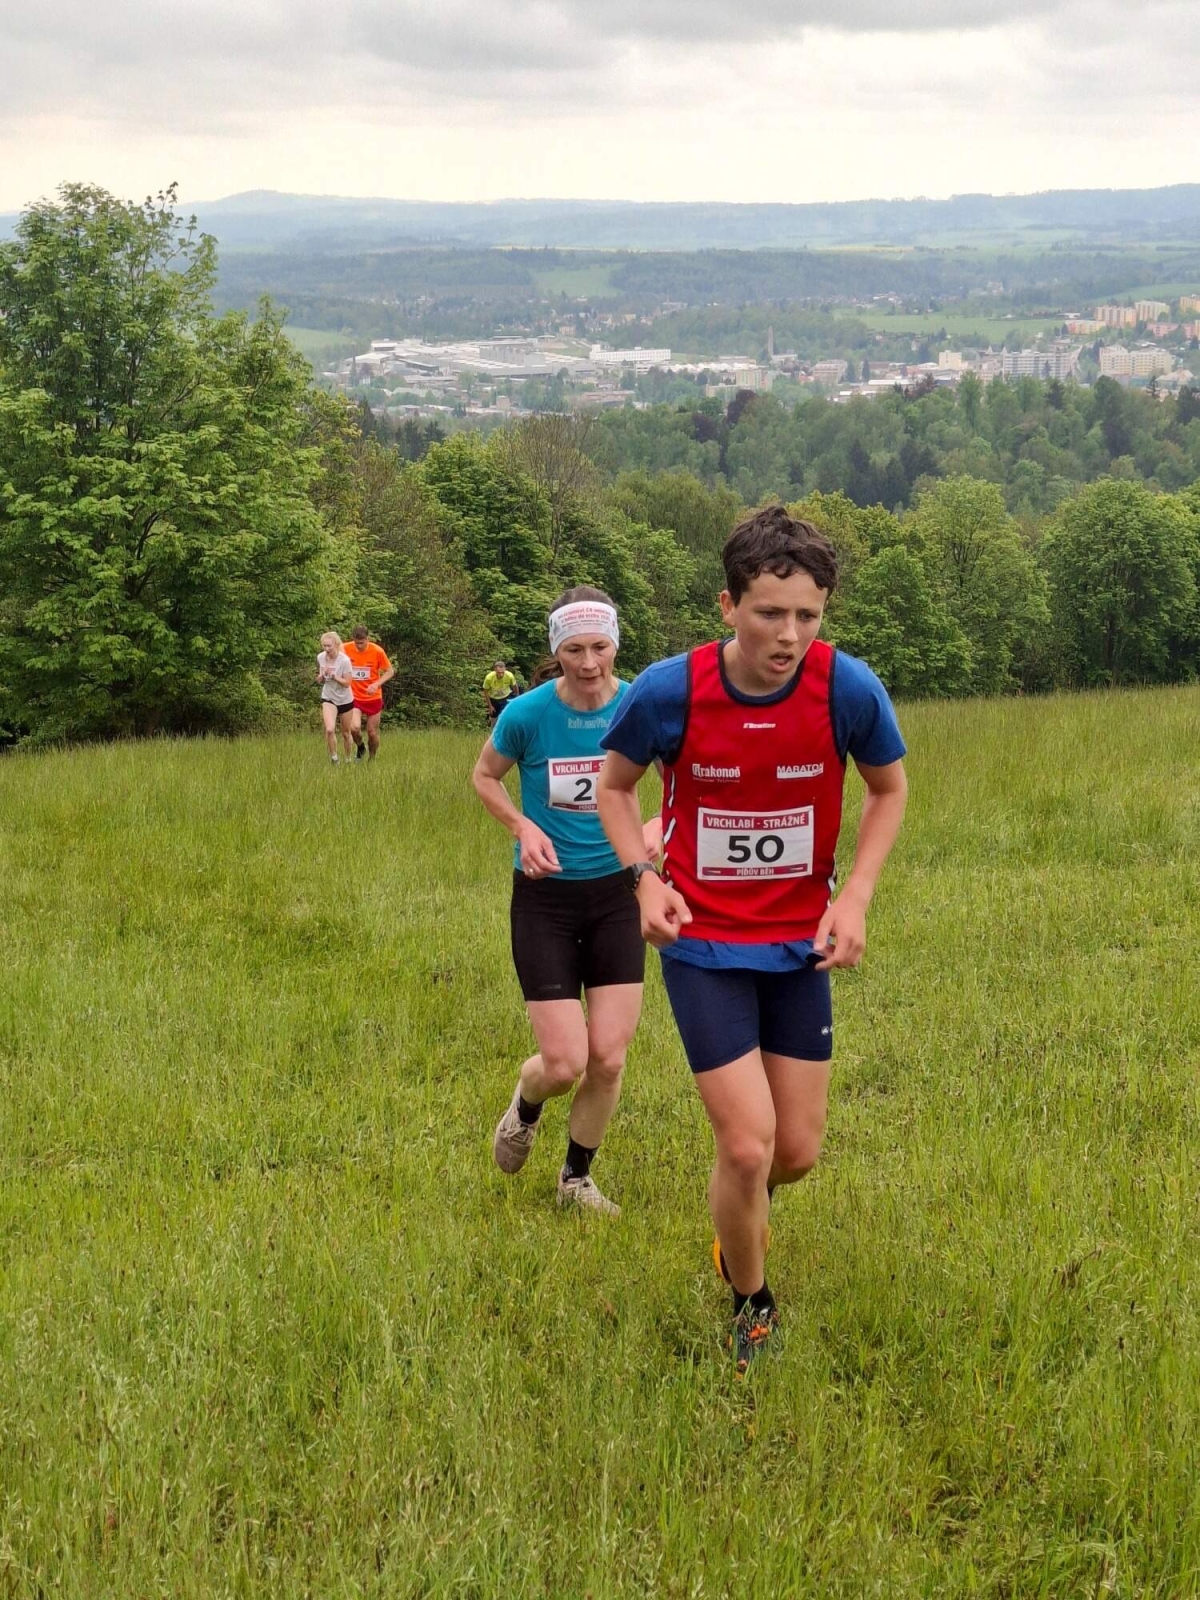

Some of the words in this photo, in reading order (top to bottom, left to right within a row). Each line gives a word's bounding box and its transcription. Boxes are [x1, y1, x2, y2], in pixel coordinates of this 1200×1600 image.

[555, 762, 592, 774] VRCHLABÍ
[573, 777, 598, 802] 2
[706, 816, 754, 829] VRCHLABÍ
[763, 814, 806, 829] STRÁŽNÉ
[727, 835, 785, 863] 50
